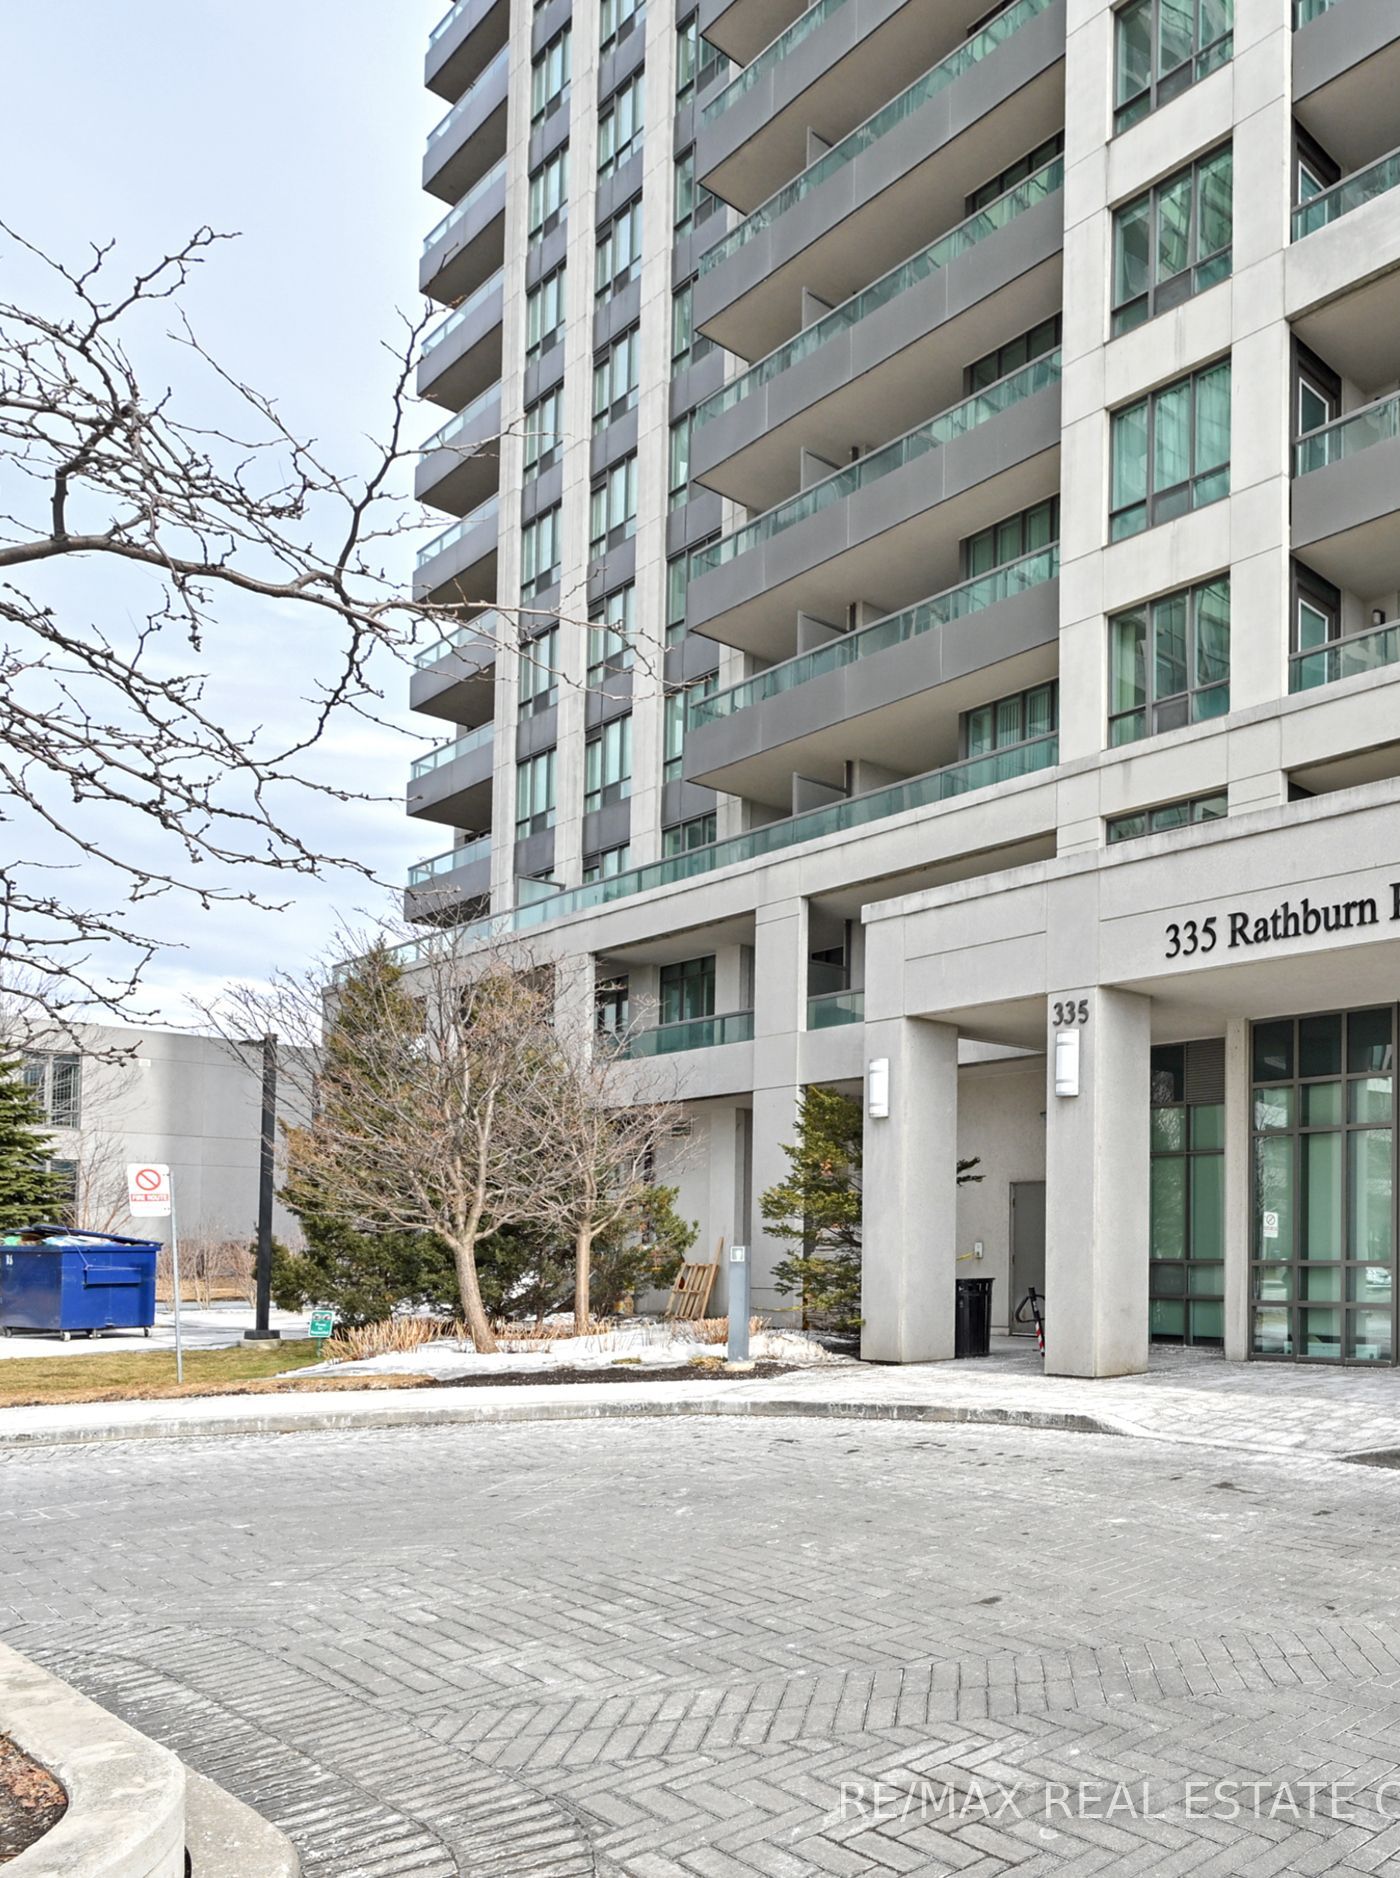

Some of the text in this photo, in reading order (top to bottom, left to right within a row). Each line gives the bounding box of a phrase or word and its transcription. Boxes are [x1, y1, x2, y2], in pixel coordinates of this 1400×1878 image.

[1165, 916, 1217, 959] 335
[1227, 898, 1379, 948] Rathburn
[1052, 999, 1089, 1026] 335
